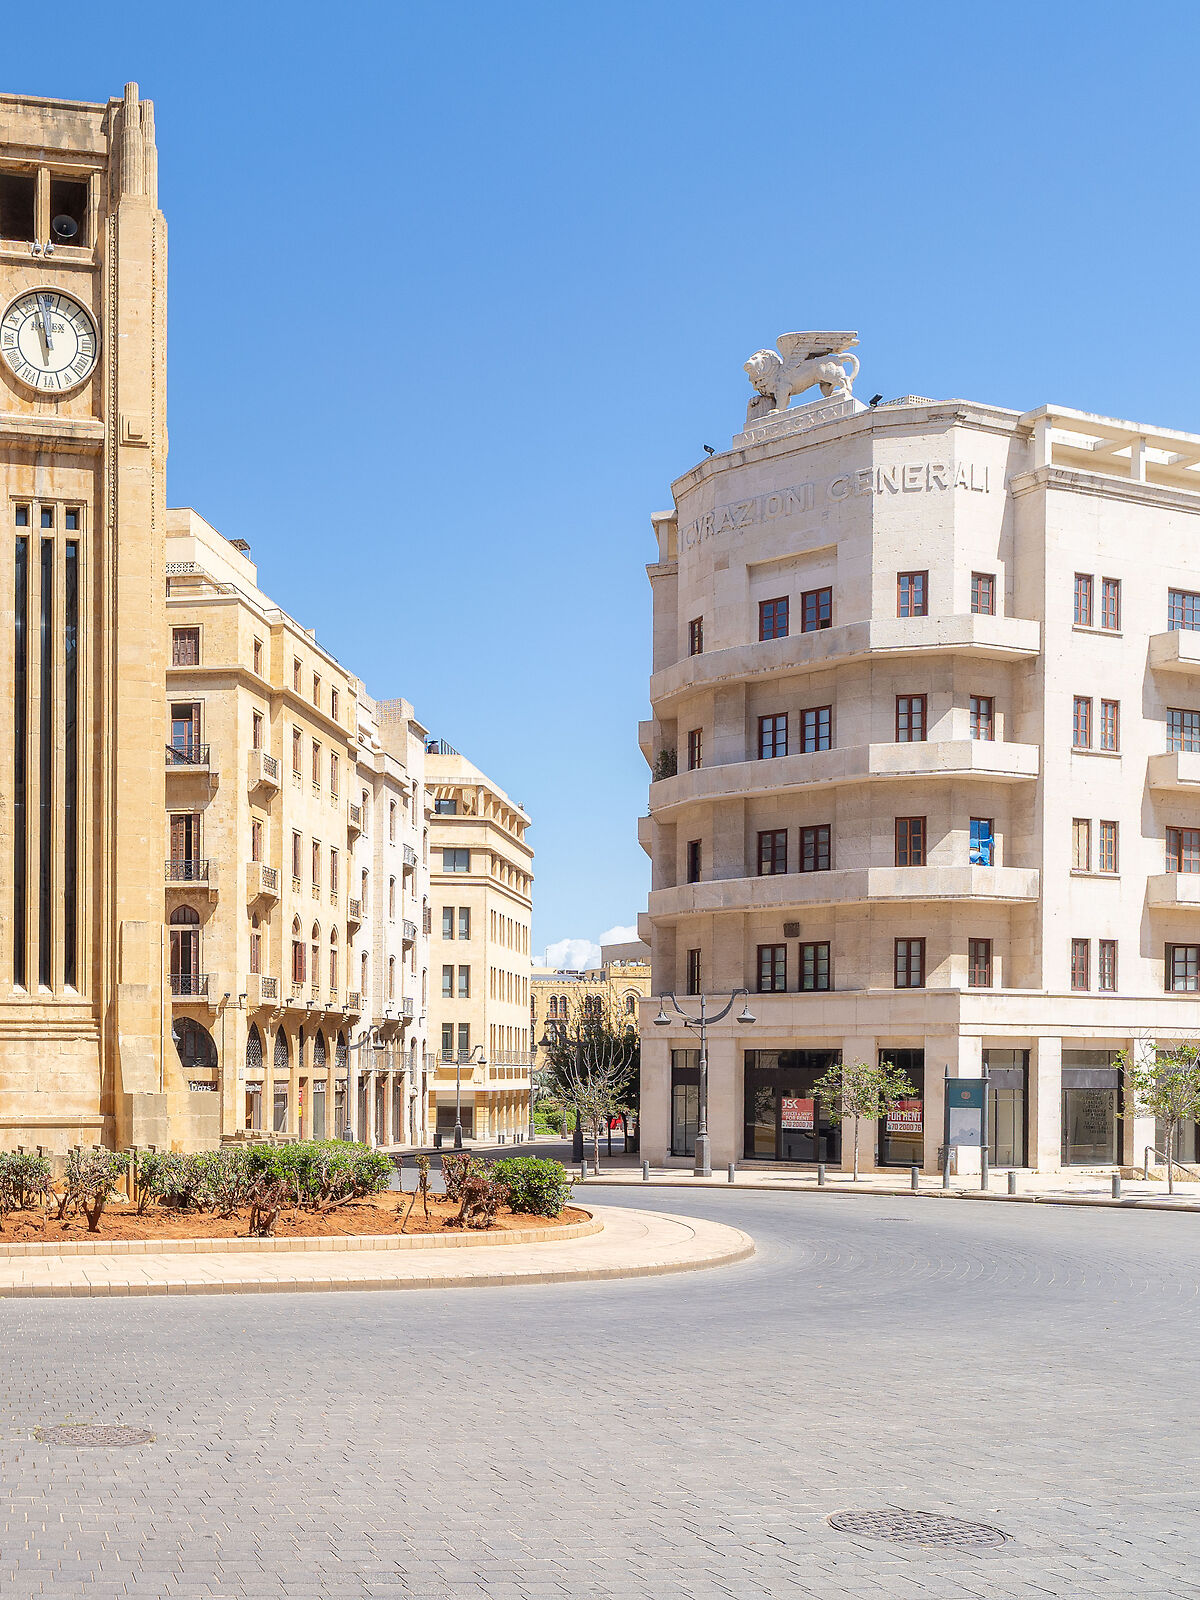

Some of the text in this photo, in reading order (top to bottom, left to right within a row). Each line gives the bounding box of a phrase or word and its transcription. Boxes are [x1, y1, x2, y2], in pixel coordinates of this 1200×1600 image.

[8, 314, 20, 326] X
[31, 321, 65, 333] ROEX
[81, 339, 92, 353] III
[22, 367, 36, 384] VII
[43, 375, 54, 387] VI
[826, 461, 990, 502] GENERALI
[782, 1099, 798, 1109] JSK
[887, 1111, 921, 1122] FOR RENT
